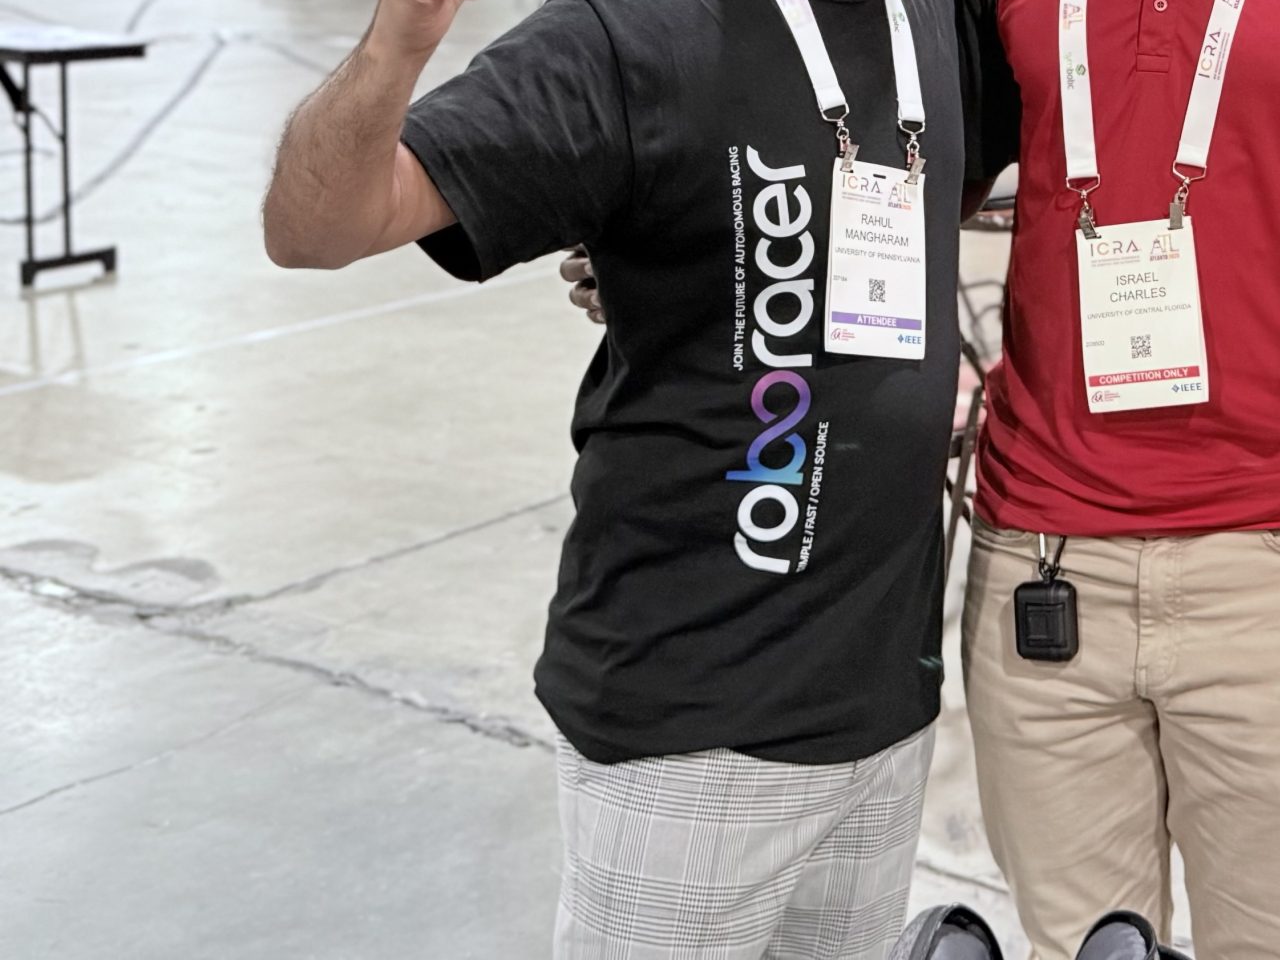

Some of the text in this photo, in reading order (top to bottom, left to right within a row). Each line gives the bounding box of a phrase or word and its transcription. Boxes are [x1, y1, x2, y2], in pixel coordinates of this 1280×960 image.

[1198, 29, 1221, 78] ICRA
[842, 174, 882, 194] ICRA
[861, 214, 893, 229] RAHUL
[845, 228, 909, 247] MANGHARAM
[835, 247, 921, 264] UNIVERSITY OF PENNSYLVANIA
[1090, 240, 1140, 257] ICRA
[728, 145, 746, 371] JOIN THE FUTURE OF AUTONOMOUS RACING
[1116, 272, 1159, 286] ISRAEL
[1110, 287, 1167, 303] CHARLES
[1087, 303, 1192, 320] UNIVERSITY OF CENTRAL FLORIDA
[857, 314, 897, 327] ATTENDEE
[904, 335, 922, 345] IEEE
[725, 144, 815, 574] roboracer
[1099, 367, 1189, 385] COMPETITION ONLY
[1180, 383, 1202, 392] IEEE
[814, 421, 829, 466] SOURCE
[810, 466, 824, 497] OPEN
[804, 503, 818, 529] FAST
